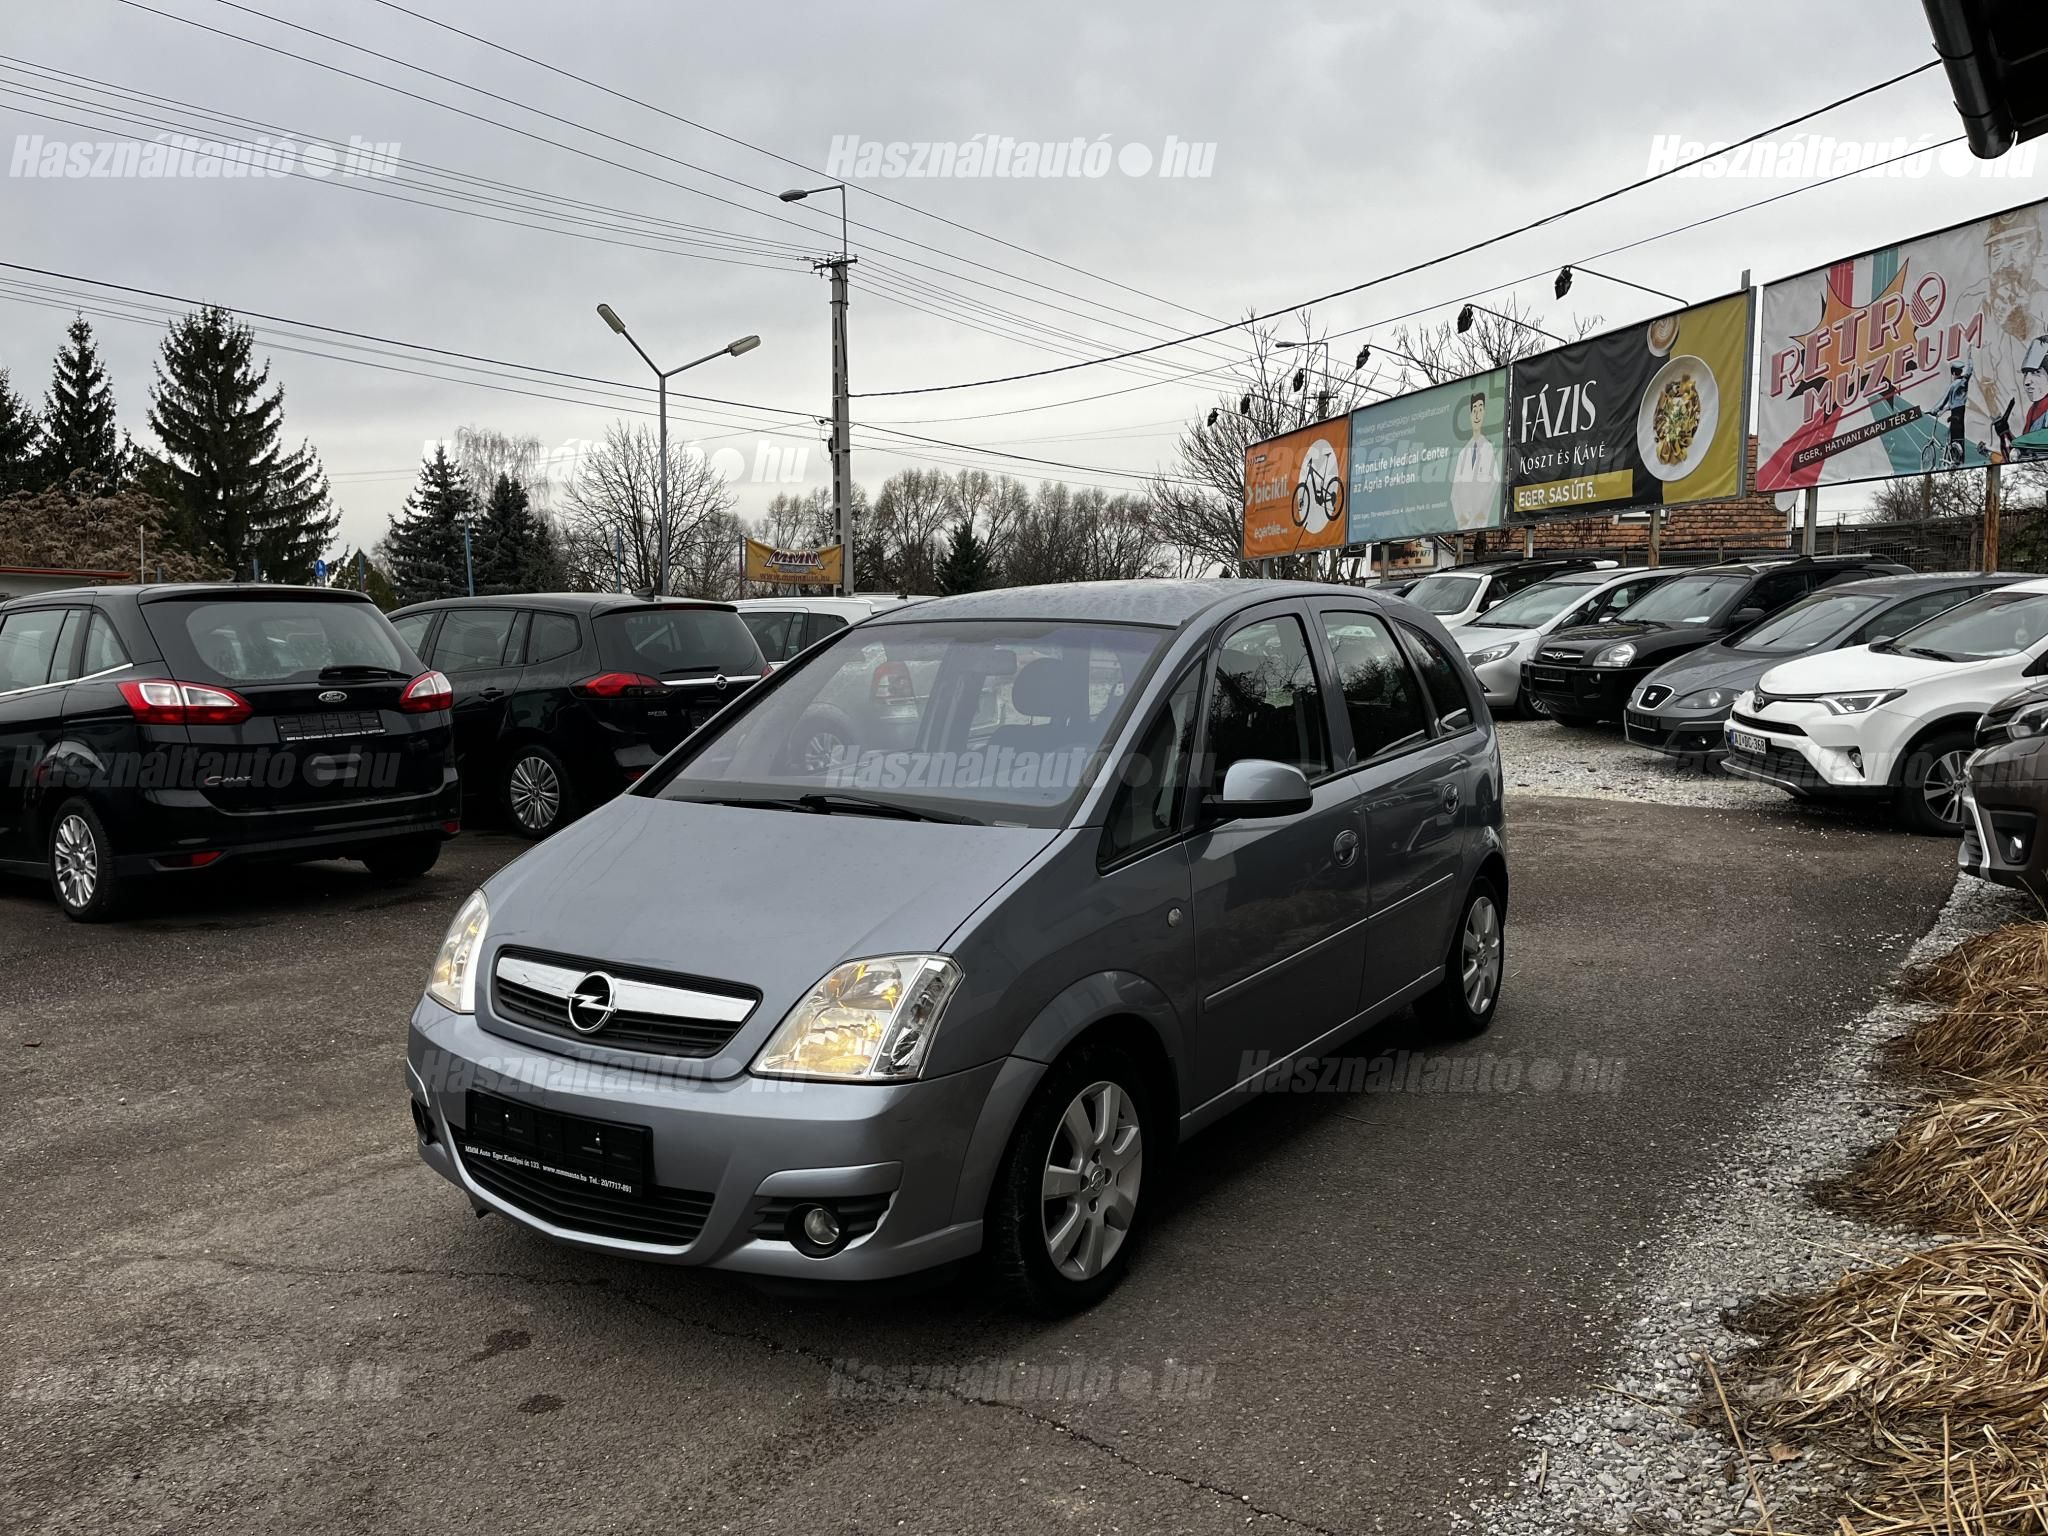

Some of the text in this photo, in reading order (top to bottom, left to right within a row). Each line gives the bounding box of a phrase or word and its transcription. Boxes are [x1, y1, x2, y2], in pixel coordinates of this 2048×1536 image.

[1769, 271, 1946, 398] RETRO
[1521, 380, 1597, 443] FÁZIS
[1798, 409, 1919, 464] EGER, HATVANI KAPU TÉR 2.
[1355, 447, 1449, 475] TritonLife Medical Center
[1519, 441, 1607, 475] KOSZT ÉS KÁVÉ
[1353, 472, 1416, 493] az Agria Parkban
[1548, 485, 1570, 504] SAS
[1571, 480, 1585, 500] ÚT
[1586, 481, 1597, 498] 5.
[479, 1148, 491, 1157] Auto
